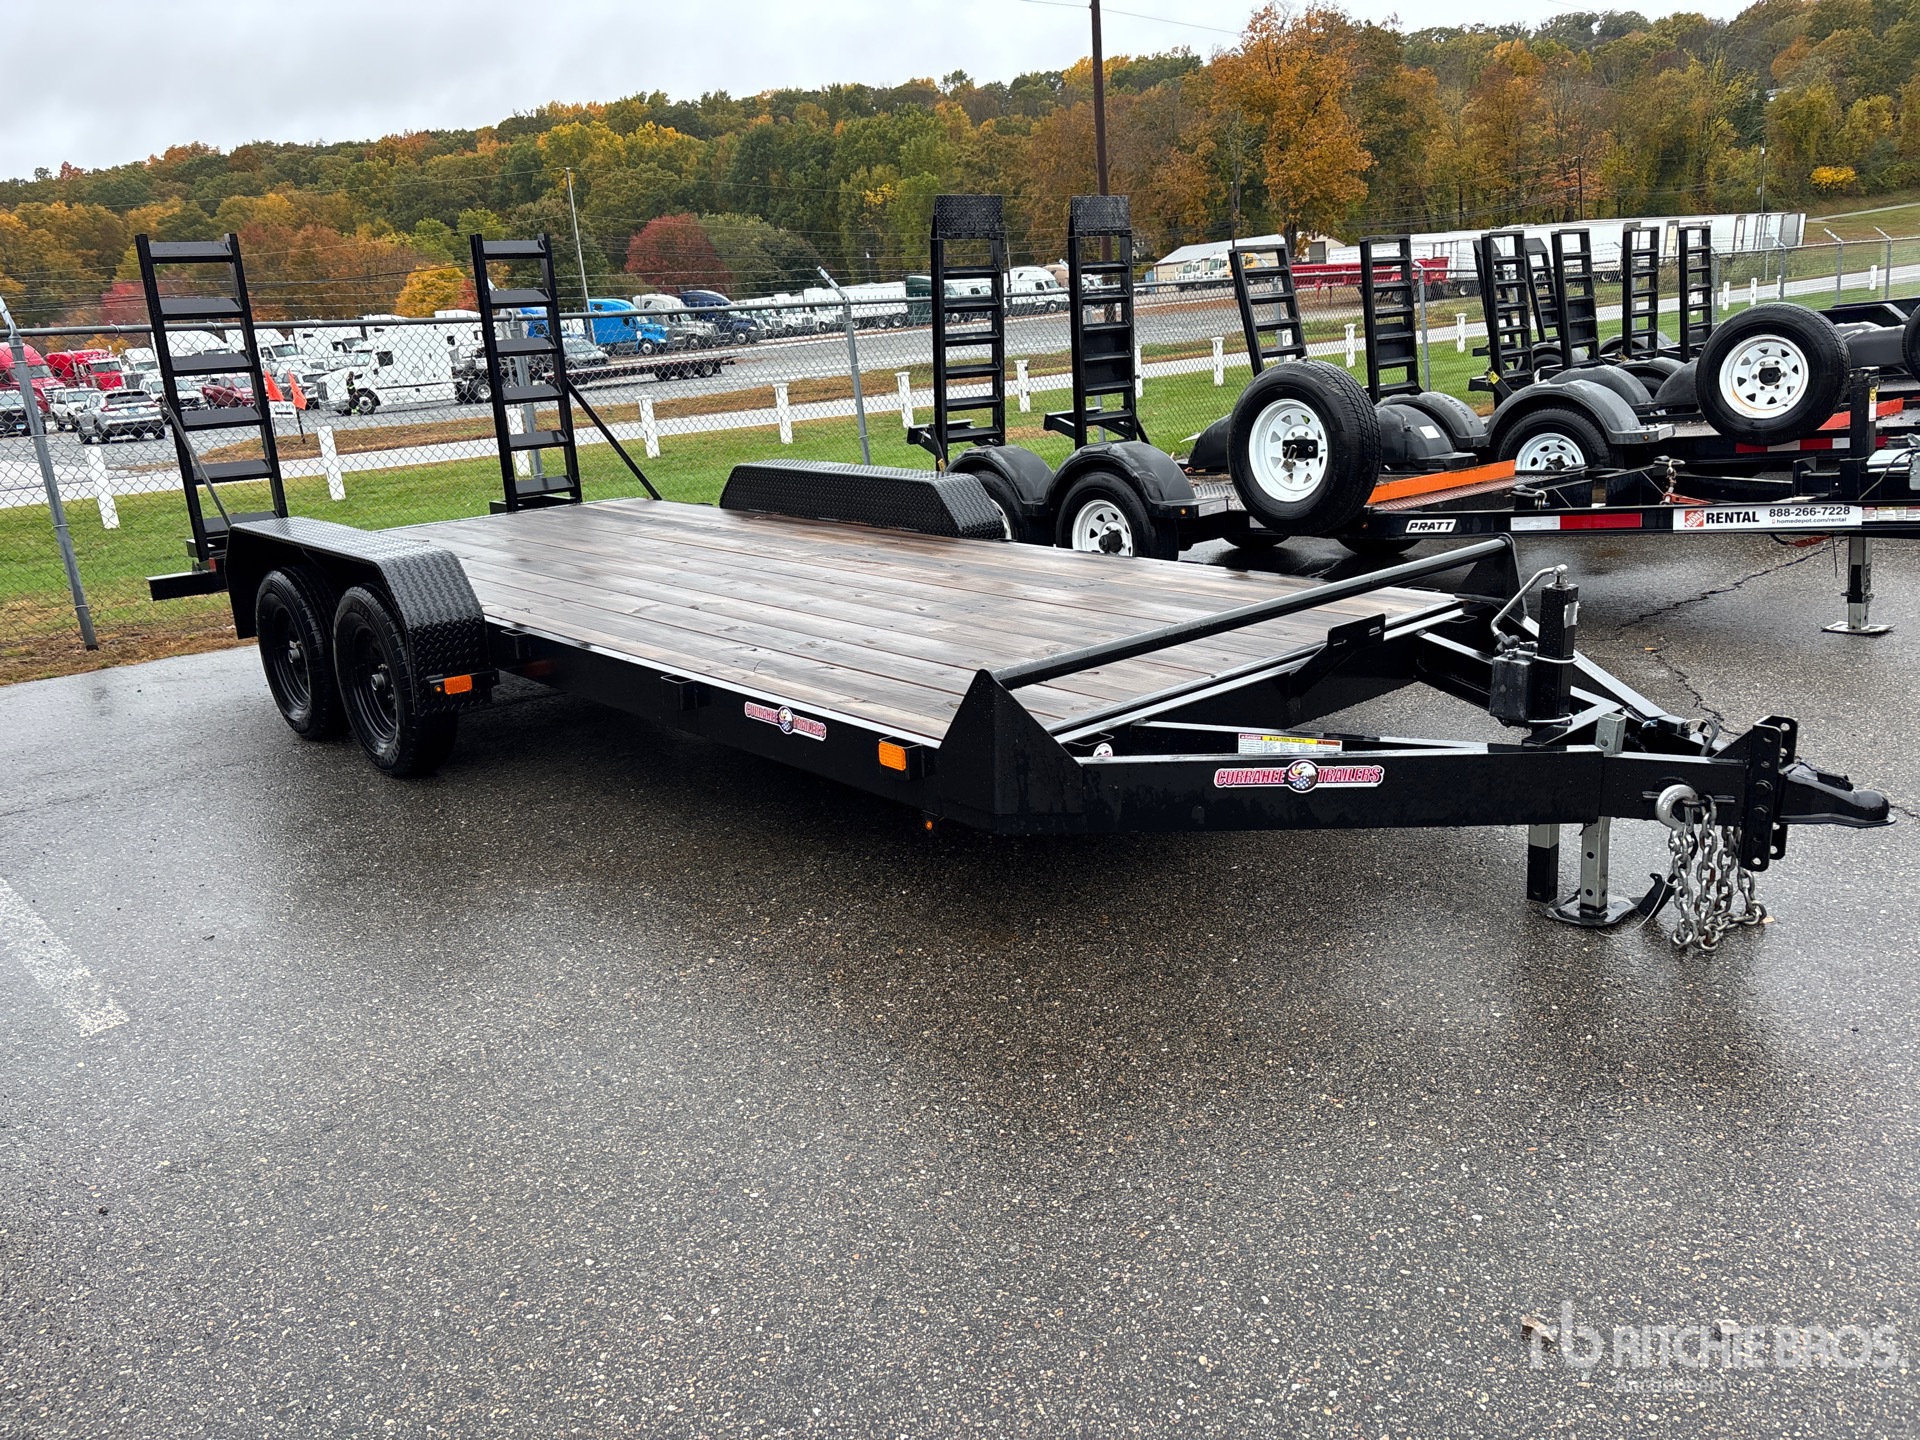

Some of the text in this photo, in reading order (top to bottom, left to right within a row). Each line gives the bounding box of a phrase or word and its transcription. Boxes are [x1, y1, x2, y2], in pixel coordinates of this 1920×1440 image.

[1705, 511, 1760, 524] RENTAL
[1768, 506, 1851, 518] 888-266-7228
[1408, 521, 1454, 531] PRATT
[1776, 517, 1847, 525] homedepot.com/rental
[1215, 767, 1382, 785] CURRAHEE TRAILERS
